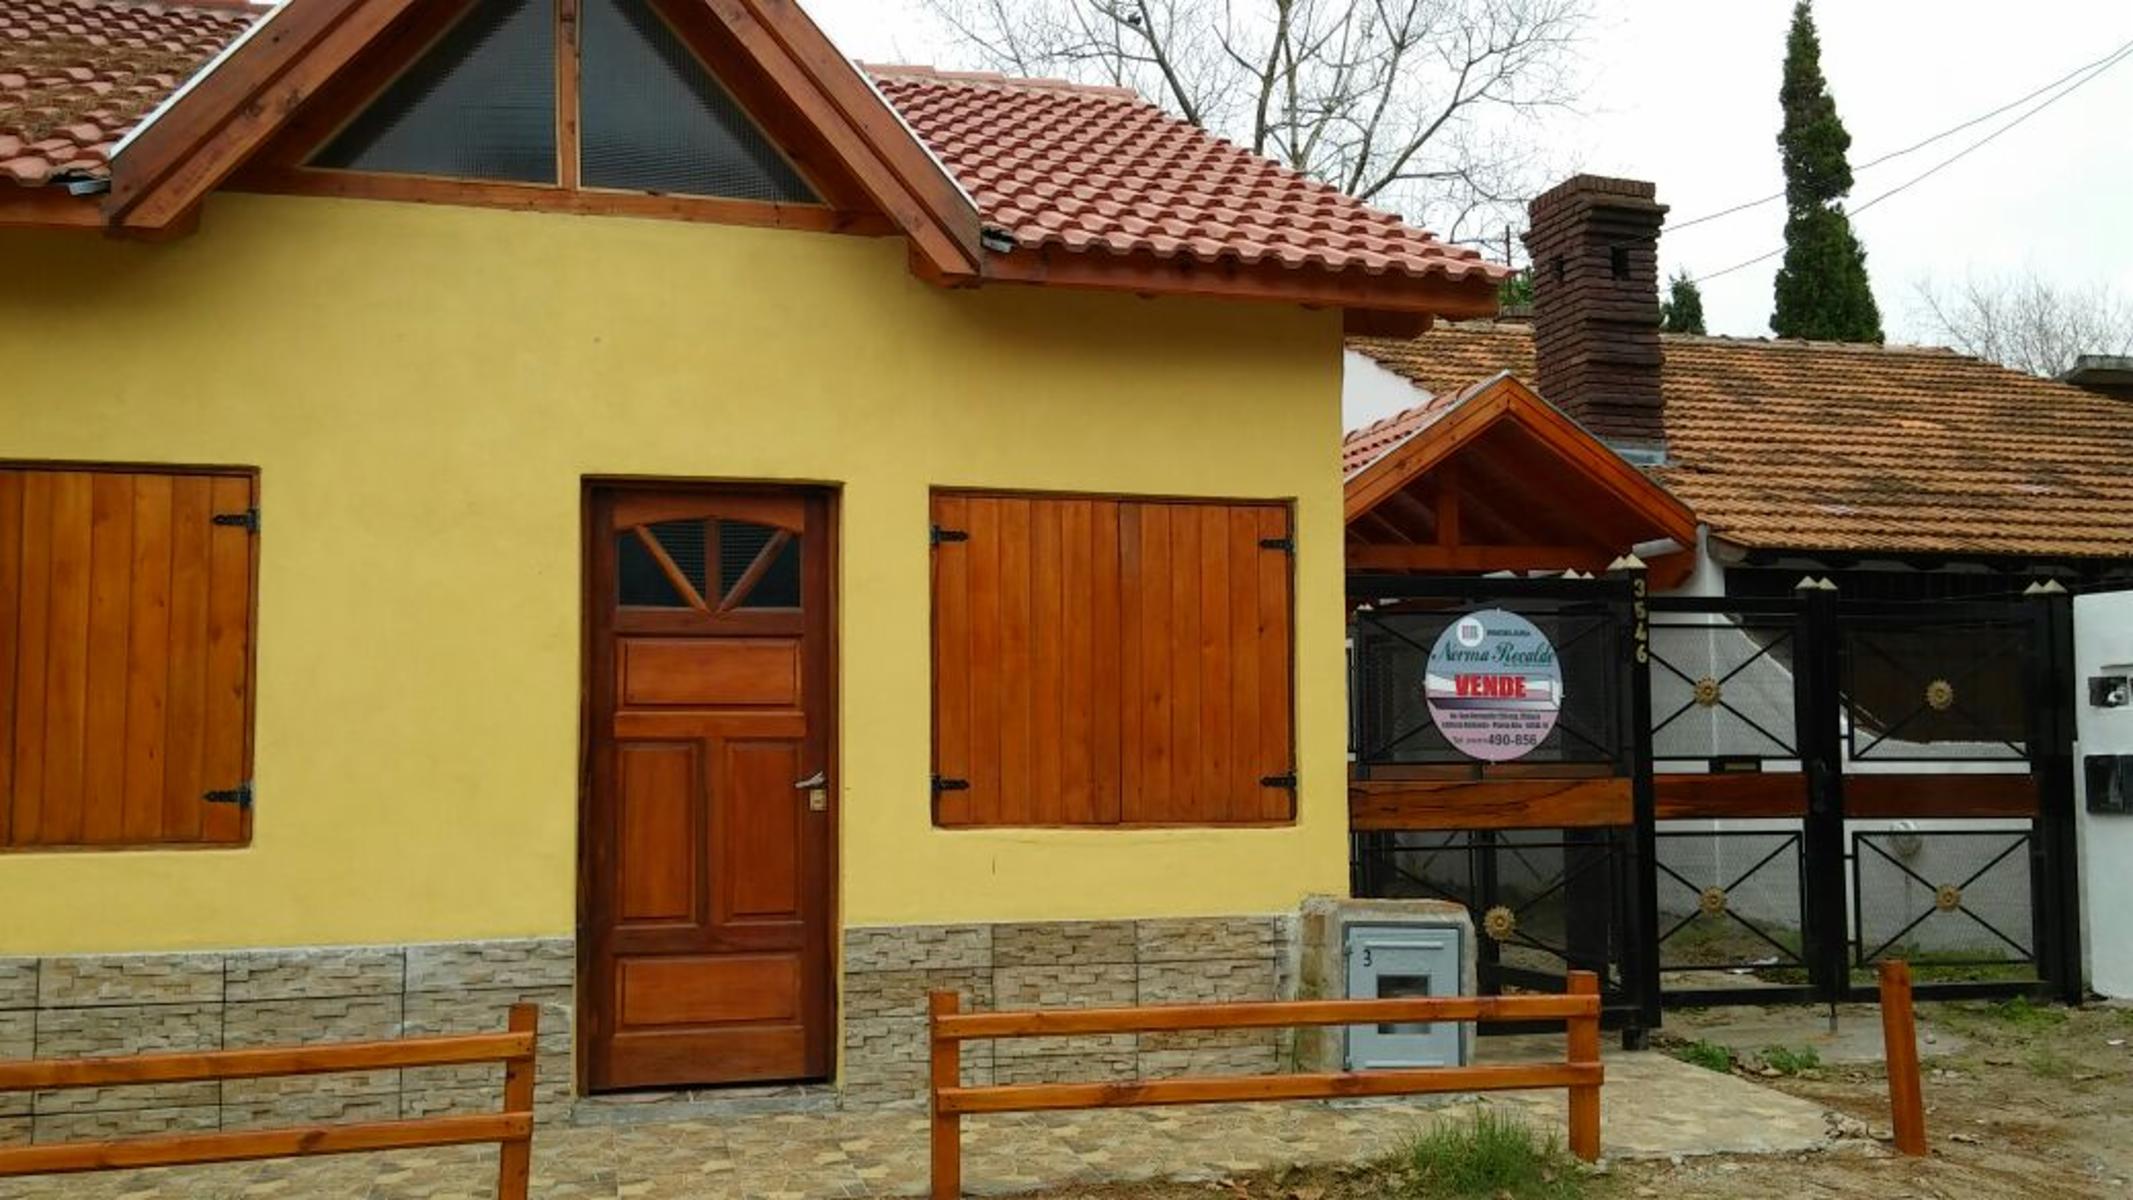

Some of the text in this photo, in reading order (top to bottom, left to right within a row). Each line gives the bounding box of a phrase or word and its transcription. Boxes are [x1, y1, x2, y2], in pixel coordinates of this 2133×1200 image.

[1633, 578, 1648, 664] 3546
[1432, 640, 1490, 662] Norma
[1454, 673, 1526, 698] VENDE
[1362, 948, 1373, 968] 3
